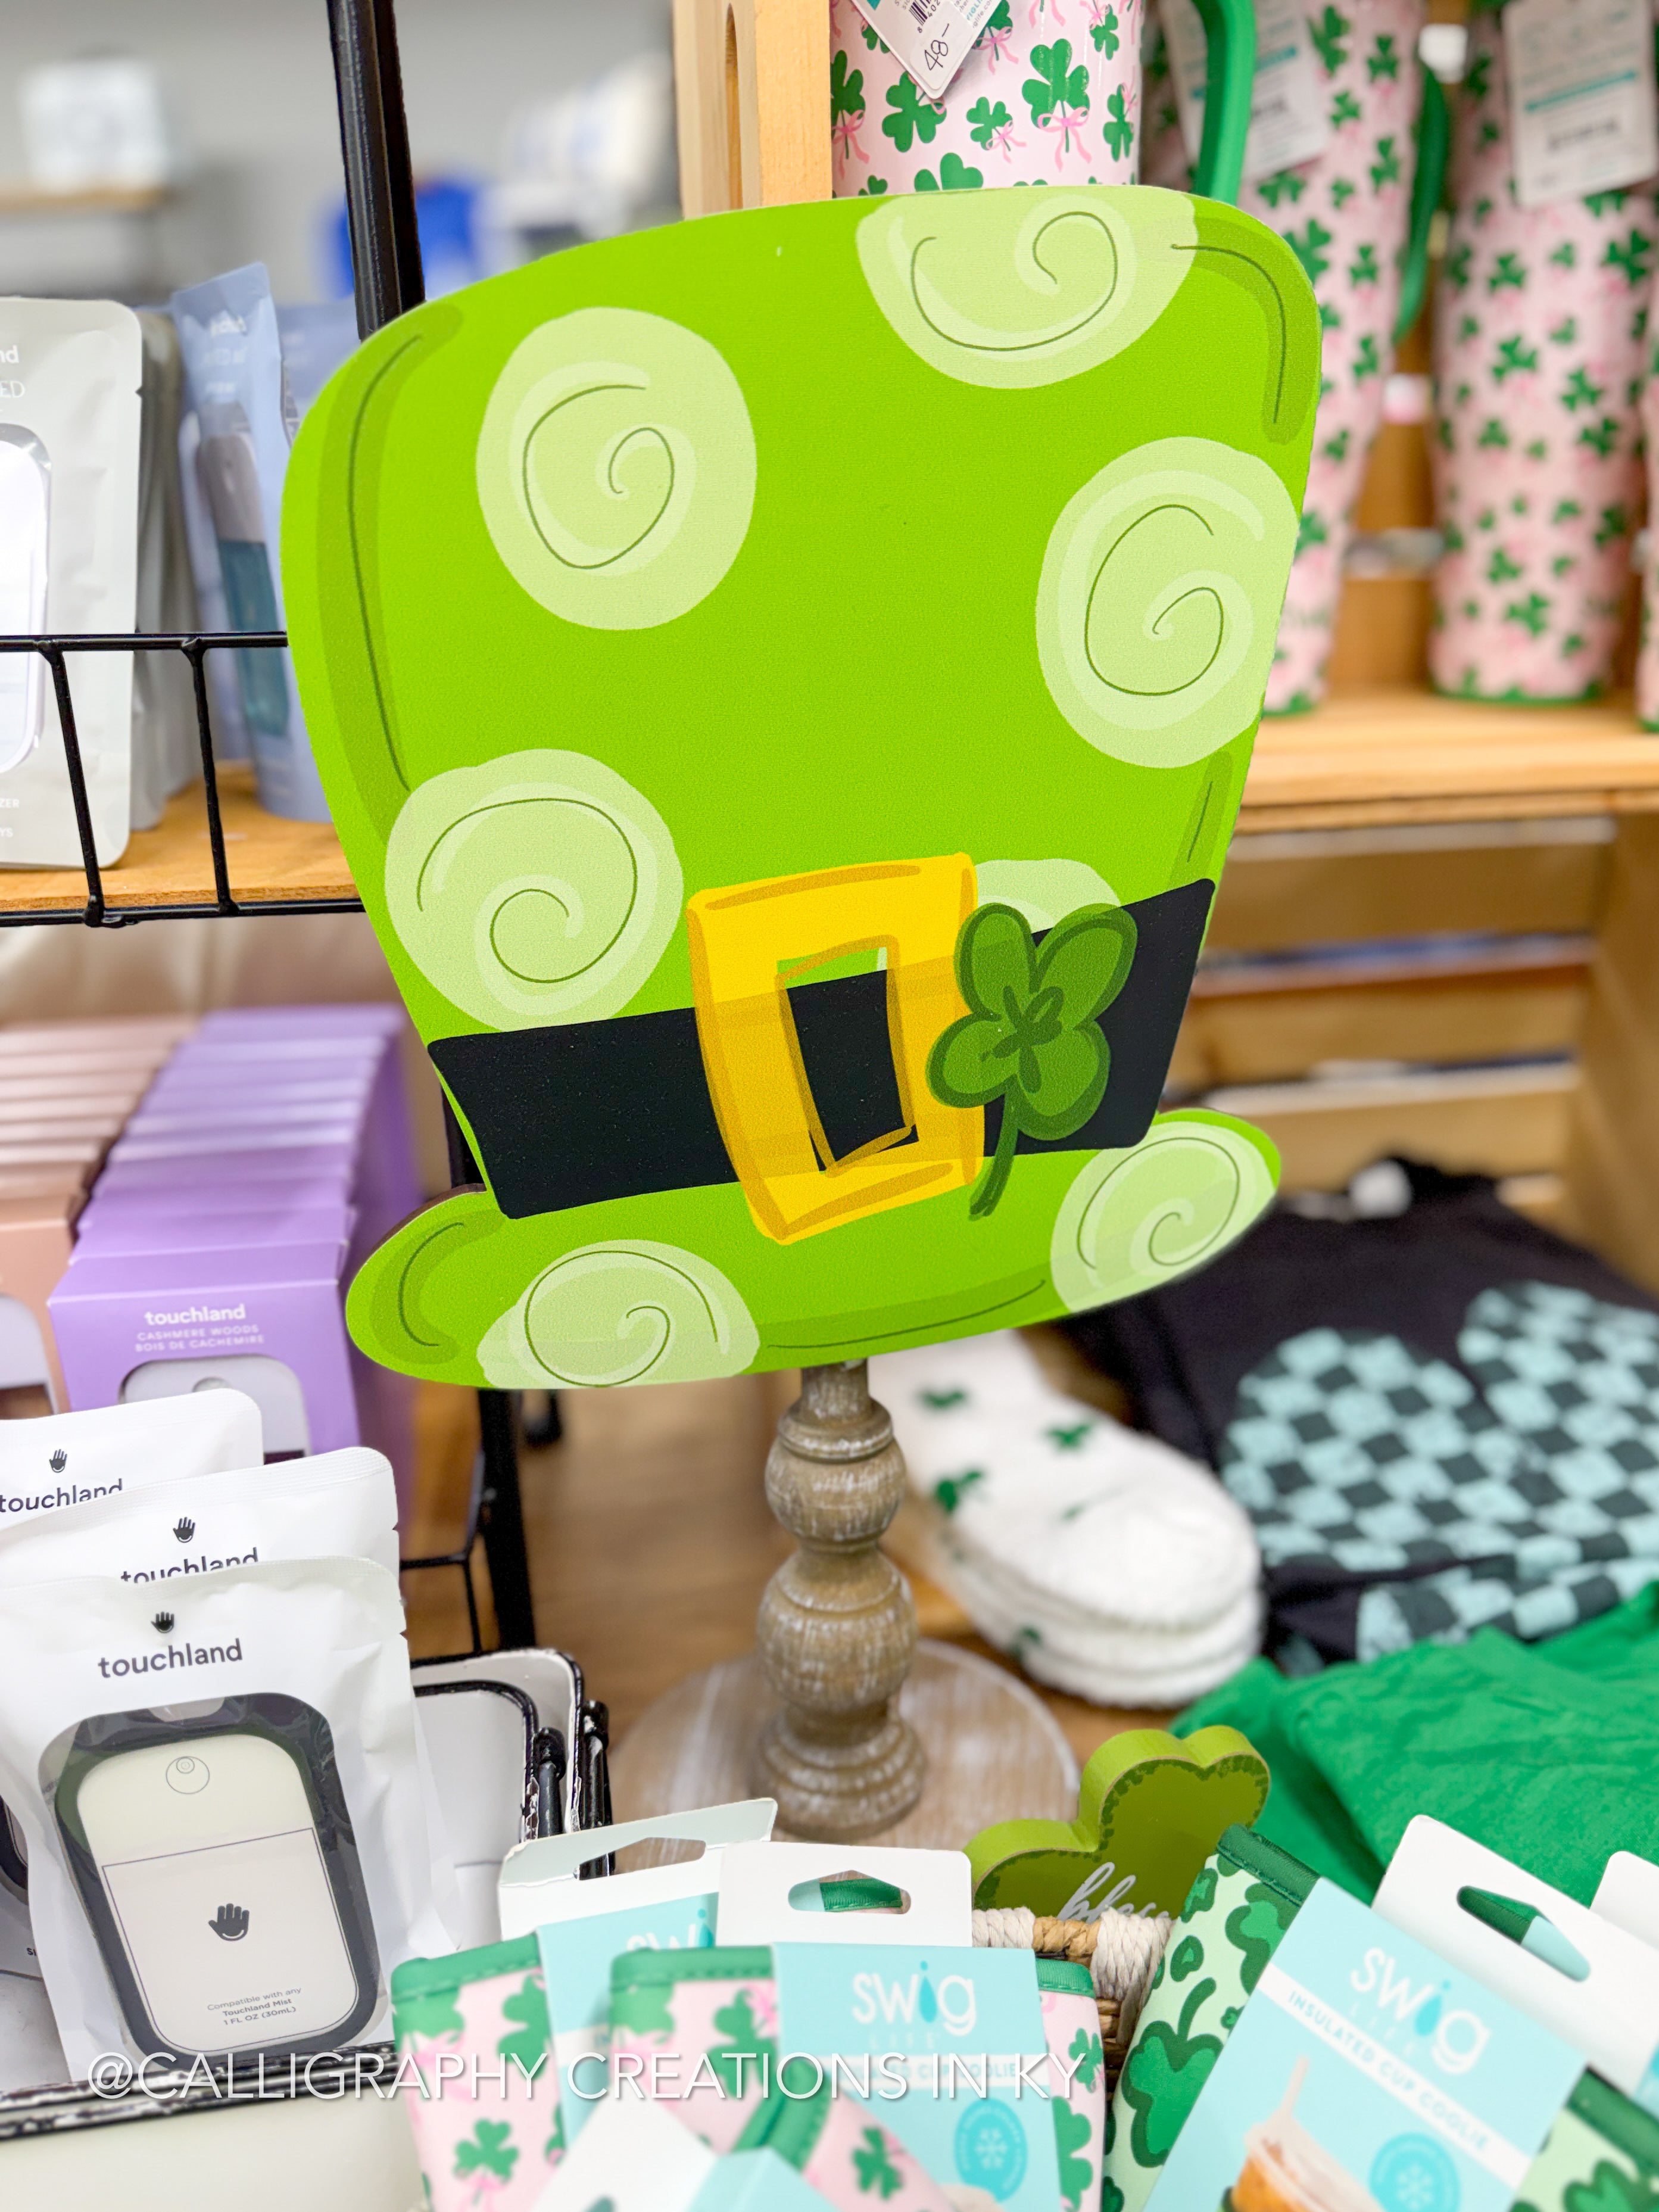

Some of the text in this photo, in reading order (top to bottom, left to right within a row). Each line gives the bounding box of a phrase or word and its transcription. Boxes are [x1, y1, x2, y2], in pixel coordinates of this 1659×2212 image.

[144, 1303, 247, 1326] touchland
[135, 1334, 264, 1352] BOIS DE CACHEMIRE
[137, 1324, 259, 1341] CASHMERE WOODS
[97, 1637, 243, 1678] touchland
[207, 1987, 302, 2011] Compatible with any
[222, 1998, 292, 2017] Touchland Mist
[852, 1959, 977, 2037] swig
[244, 2013, 260, 2021] OZ
[261, 2006, 297, 2019] (30mL)
[1287, 1990, 1490, 2150] INSULATED CUP COOLIE
